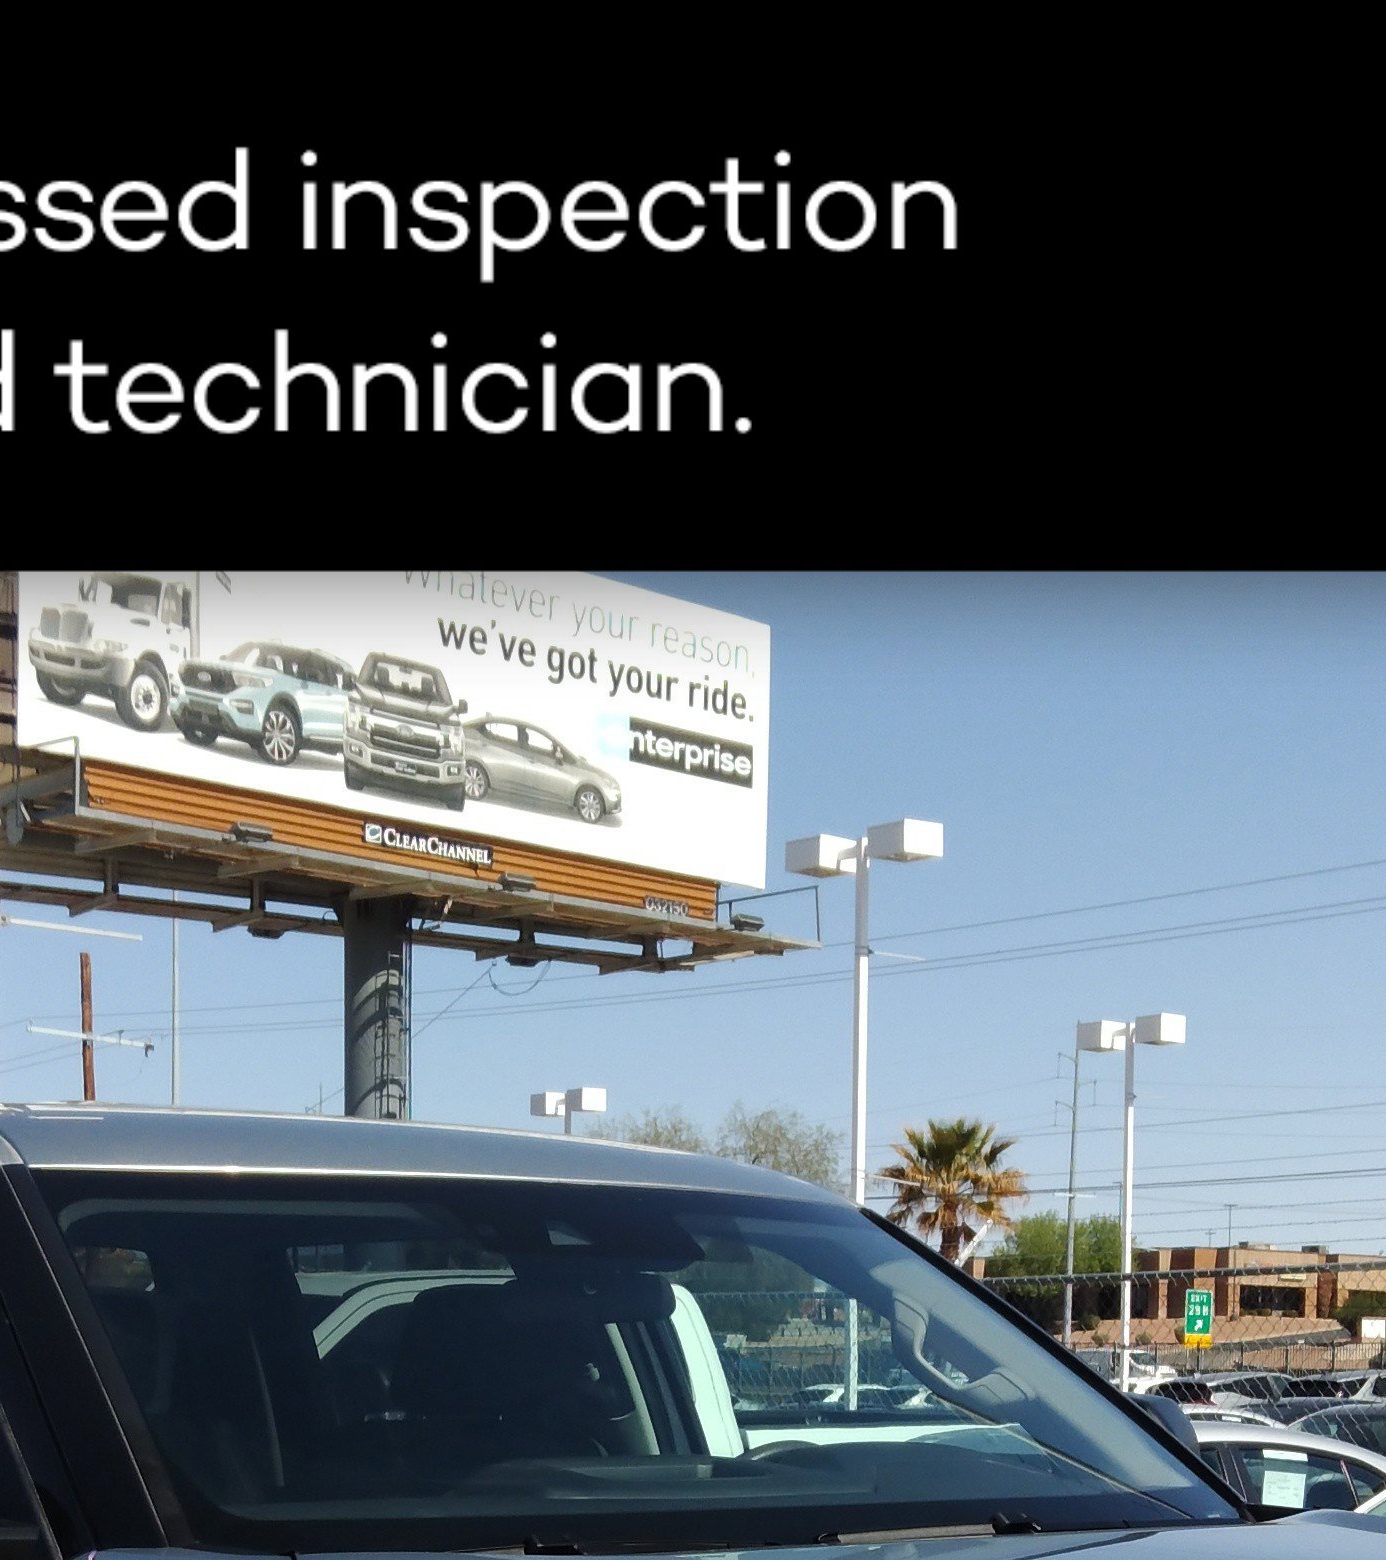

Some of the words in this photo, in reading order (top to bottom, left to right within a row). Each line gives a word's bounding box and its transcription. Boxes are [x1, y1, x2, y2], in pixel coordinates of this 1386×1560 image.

[572, 601, 640, 642] your
[437, 616, 537, 668] we've
[547, 645, 598, 685] got
[608, 659, 680, 702] your
[688, 674, 755, 722] ride.
